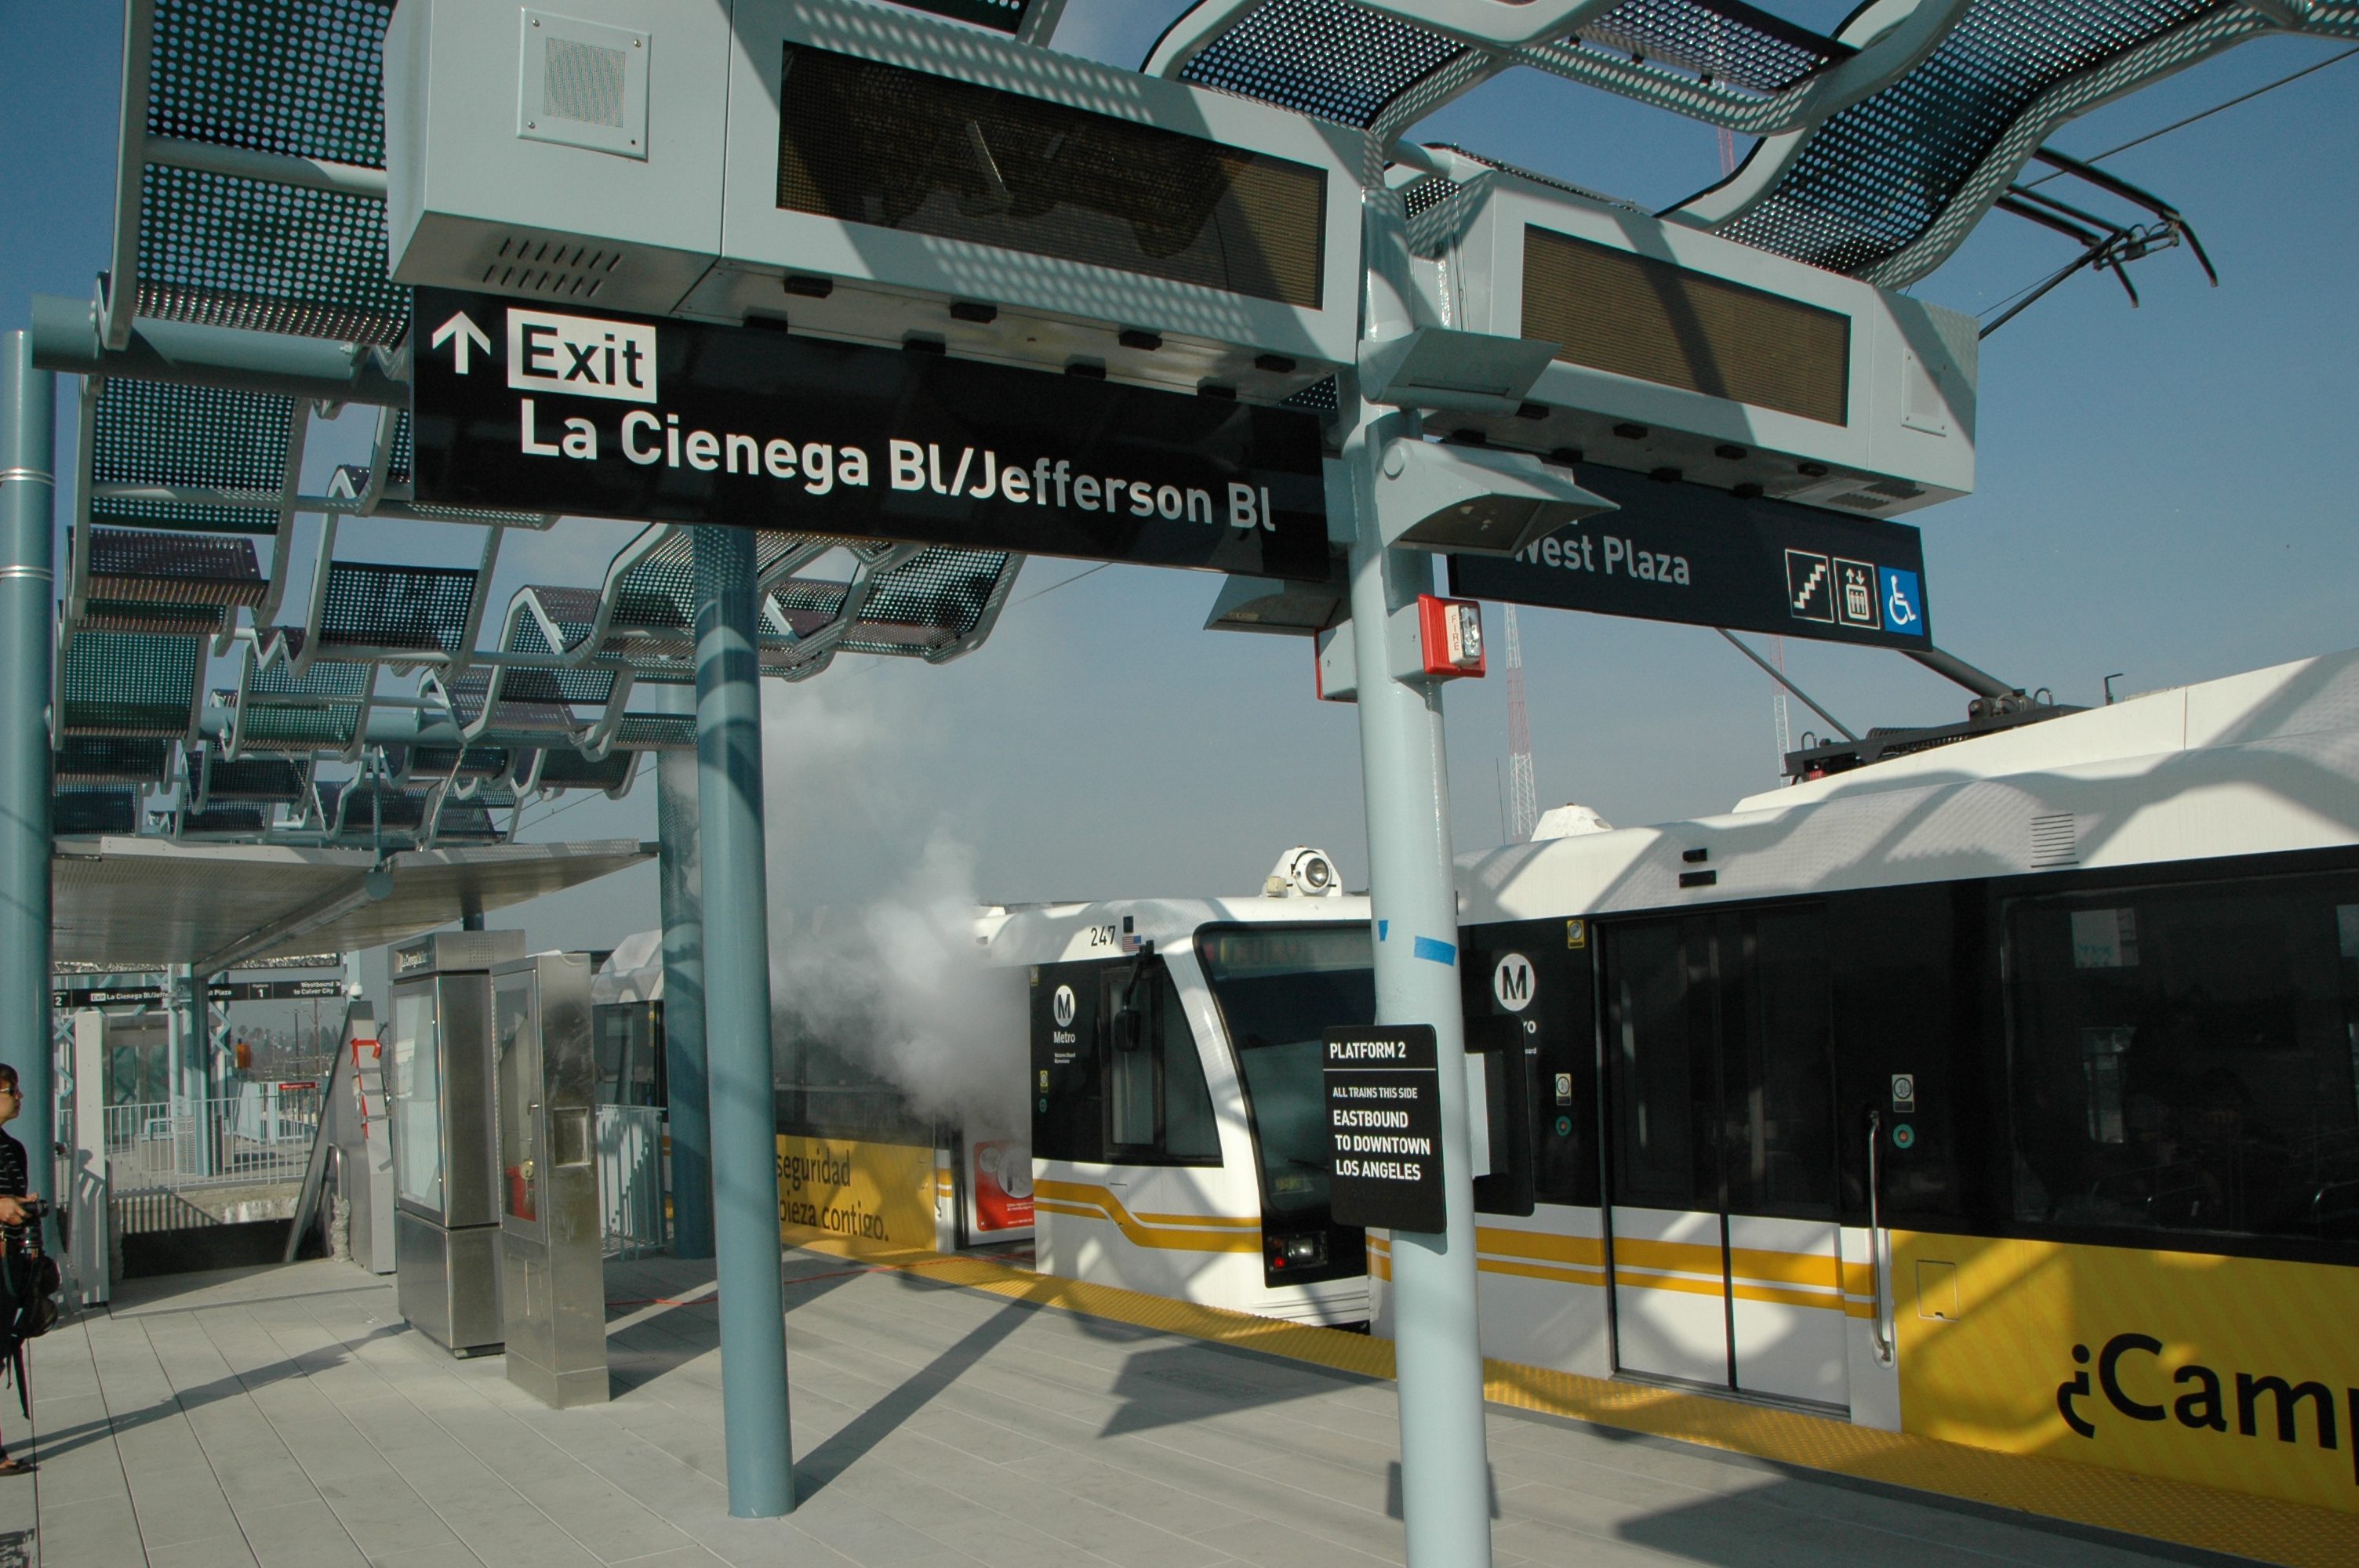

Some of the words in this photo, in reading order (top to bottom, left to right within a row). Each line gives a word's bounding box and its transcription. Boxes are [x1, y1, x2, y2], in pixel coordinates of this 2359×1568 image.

[522, 323, 644, 389] Exit
[522, 398, 598, 460] La
[621, 410, 869, 495] Cienega
[889, 439, 1213, 524] Bl/Jefferson
[1228, 482, 1275, 532] Bl
[1603, 535, 1690, 586] Plaza
[1091, 925, 1116, 946] 247
[1502, 964, 1527, 1000] M
[54, 996, 62, 1007] 2
[258, 989, 264, 998] 1
[1057, 993, 1071, 1019] M
[1053, 1031, 1075, 1044] Metro
[1330, 1042, 1395, 1059] PLATFORM
[1398, 1042, 1406, 1058] 2
[1333, 1087, 1347, 1098] ALL
[1349, 1087, 1377, 1098] TRAINS
[1379, 1087, 1398, 1098] THIS
[1398, 1087, 1418, 1099] SIDE
[1333, 1110, 1408, 1127] EASTBOUND
[1335, 1134, 1350, 1151] TO
[1354, 1135, 1430, 1155] DOWNTOWN
[776, 1148, 851, 1192] seguridad
[1336, 1160, 1360, 1177] LOS
[1362, 1161, 1421, 1181] ANGELES
[821, 1200, 889, 1242] contigo.
